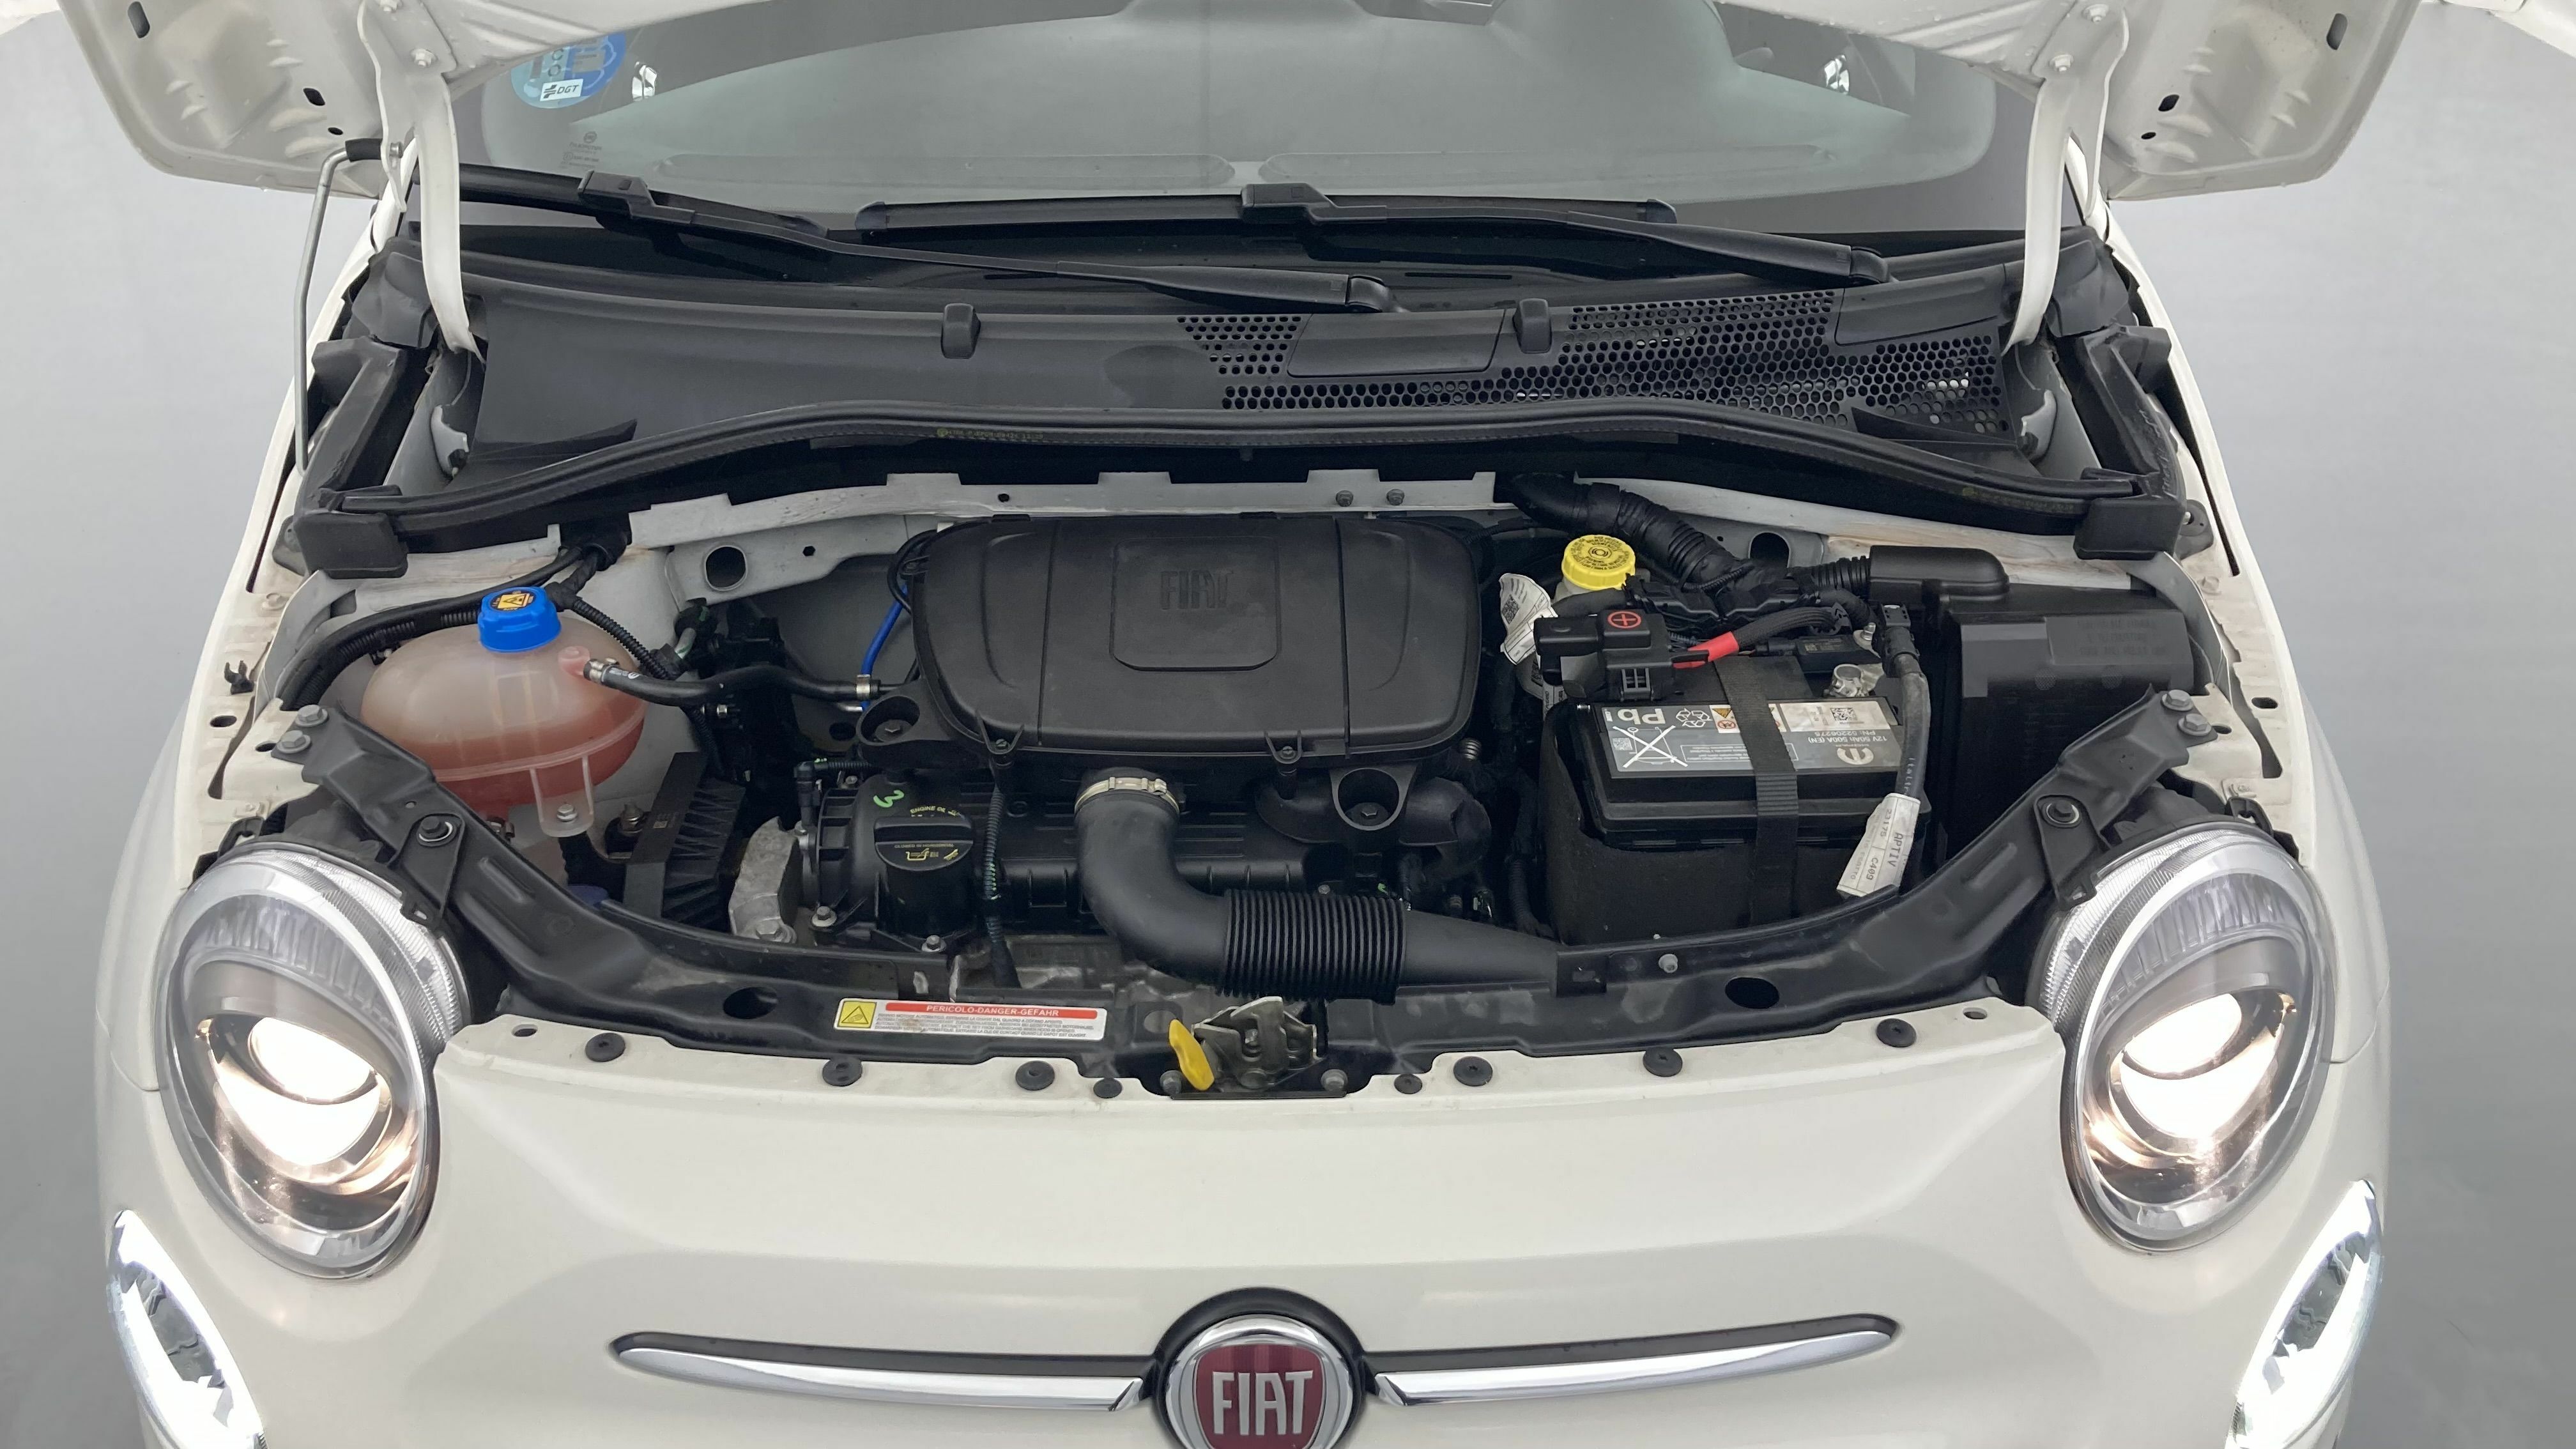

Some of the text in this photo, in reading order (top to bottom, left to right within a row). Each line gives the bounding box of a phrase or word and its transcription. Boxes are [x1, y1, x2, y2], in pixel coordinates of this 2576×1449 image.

[556, 85, 579, 94] DGT
[1617, 708, 1666, 724] Pb
[910, 806, 936, 814] ENGINE
[1888, 832, 1903, 868] APTIV
[1866, 857, 1879, 880] C409
[926, 1006, 1059, 1016] PERICOLO-DANGER-GEFAHR
[1212, 1370, 1314, 1436] FIAT
